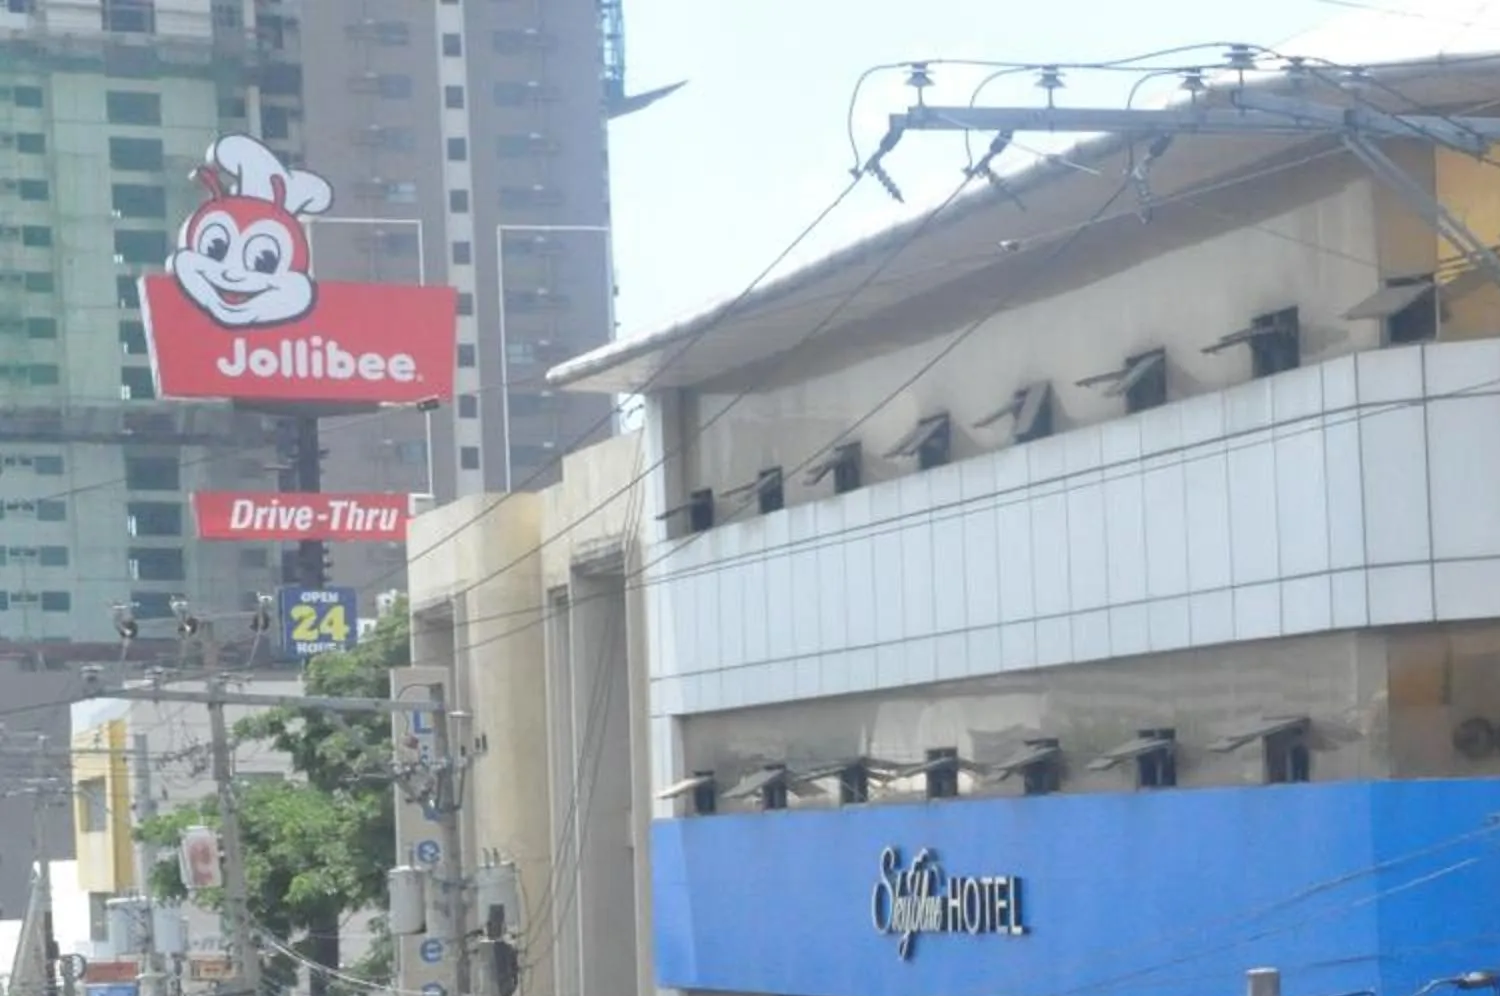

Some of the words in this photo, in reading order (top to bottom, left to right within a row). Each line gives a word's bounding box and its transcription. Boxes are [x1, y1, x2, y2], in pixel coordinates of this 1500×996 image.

[216, 336, 417, 382] Jollibee
[229, 499, 398, 532] Drive-Thru
[301, 591, 339, 603] OPEN
[291, 604, 349, 641] 24
[947, 877, 1024, 934] HOTEL
